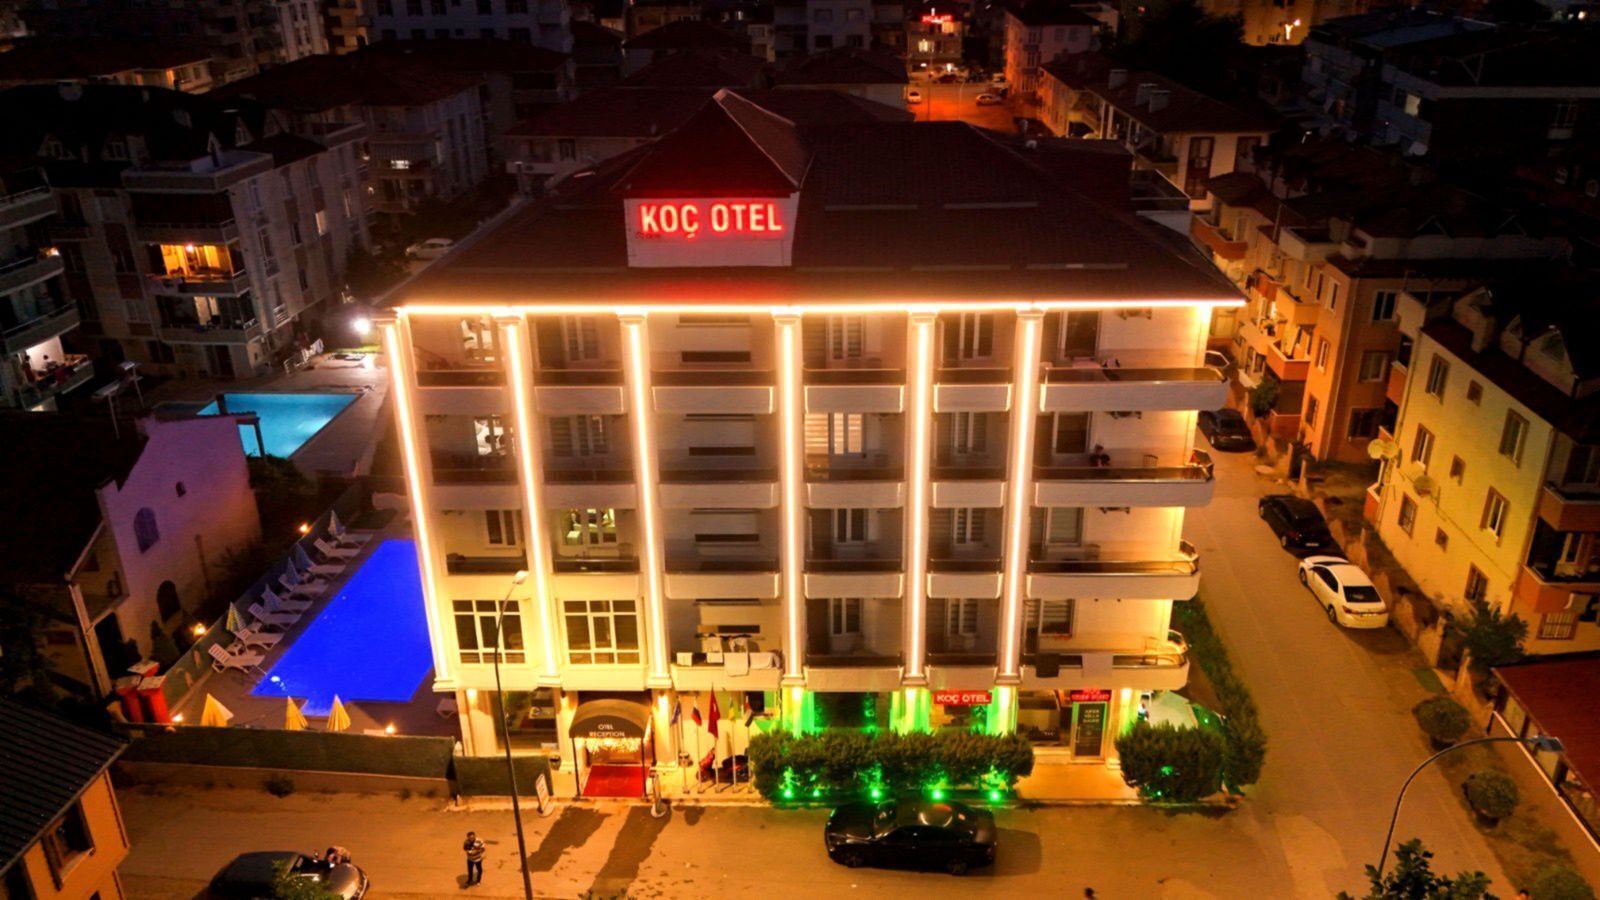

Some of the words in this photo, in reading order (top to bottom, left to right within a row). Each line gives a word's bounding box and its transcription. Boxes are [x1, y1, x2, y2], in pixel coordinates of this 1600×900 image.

[640, 204, 699, 239] KOÇ
[711, 203, 782, 232] OTEL
[937, 694, 960, 704] KOÇ
[962, 694, 990, 703] OTEL
